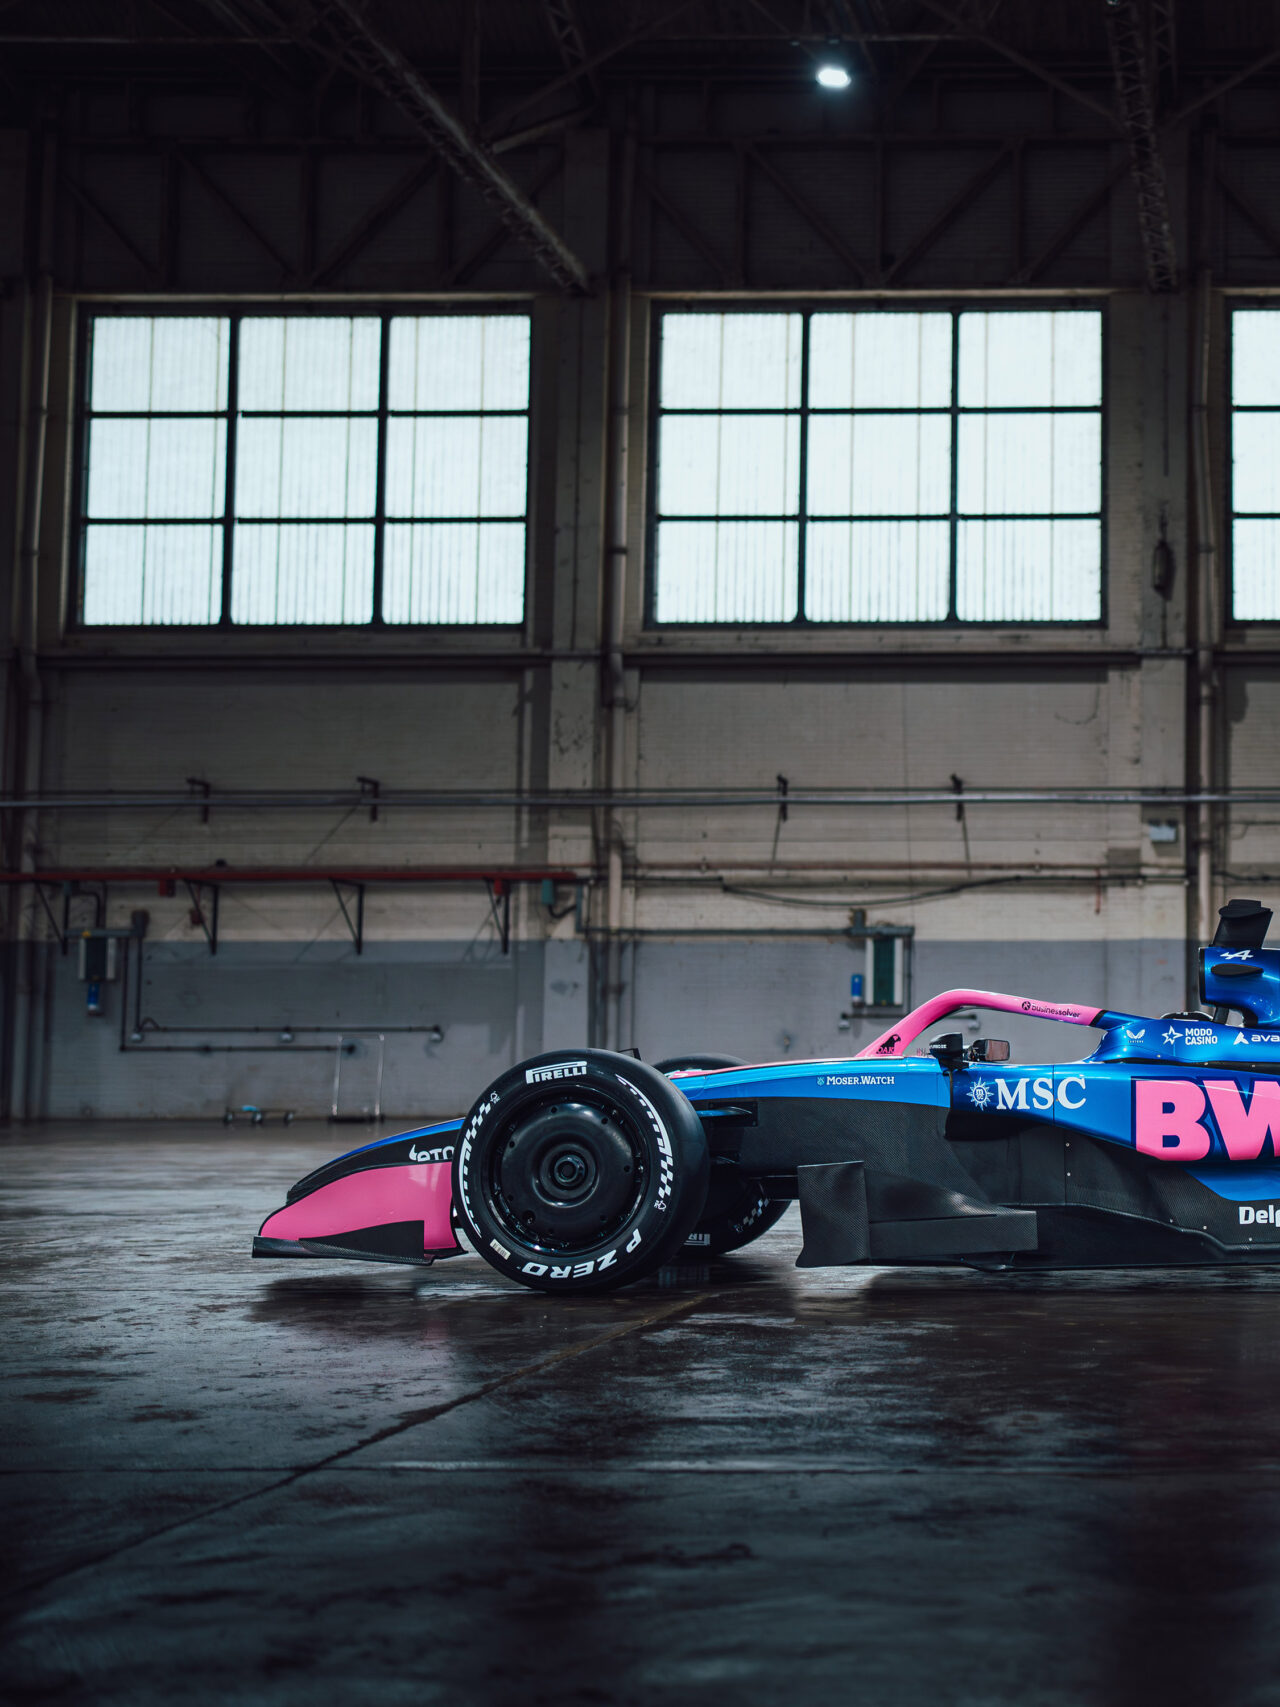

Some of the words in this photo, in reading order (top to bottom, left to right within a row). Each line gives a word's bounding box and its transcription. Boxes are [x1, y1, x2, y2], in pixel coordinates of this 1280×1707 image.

[1185, 1028, 1213, 1037] MODO
[1185, 1036, 1218, 1046] CASINO
[526, 1061, 588, 1084] PIRELLI
[826, 1075, 895, 1086] MOSER.WATCH
[995, 1077, 1087, 1110] MSC
[626, 1228, 642, 1254] P
[521, 1249, 618, 1279] ZERO
